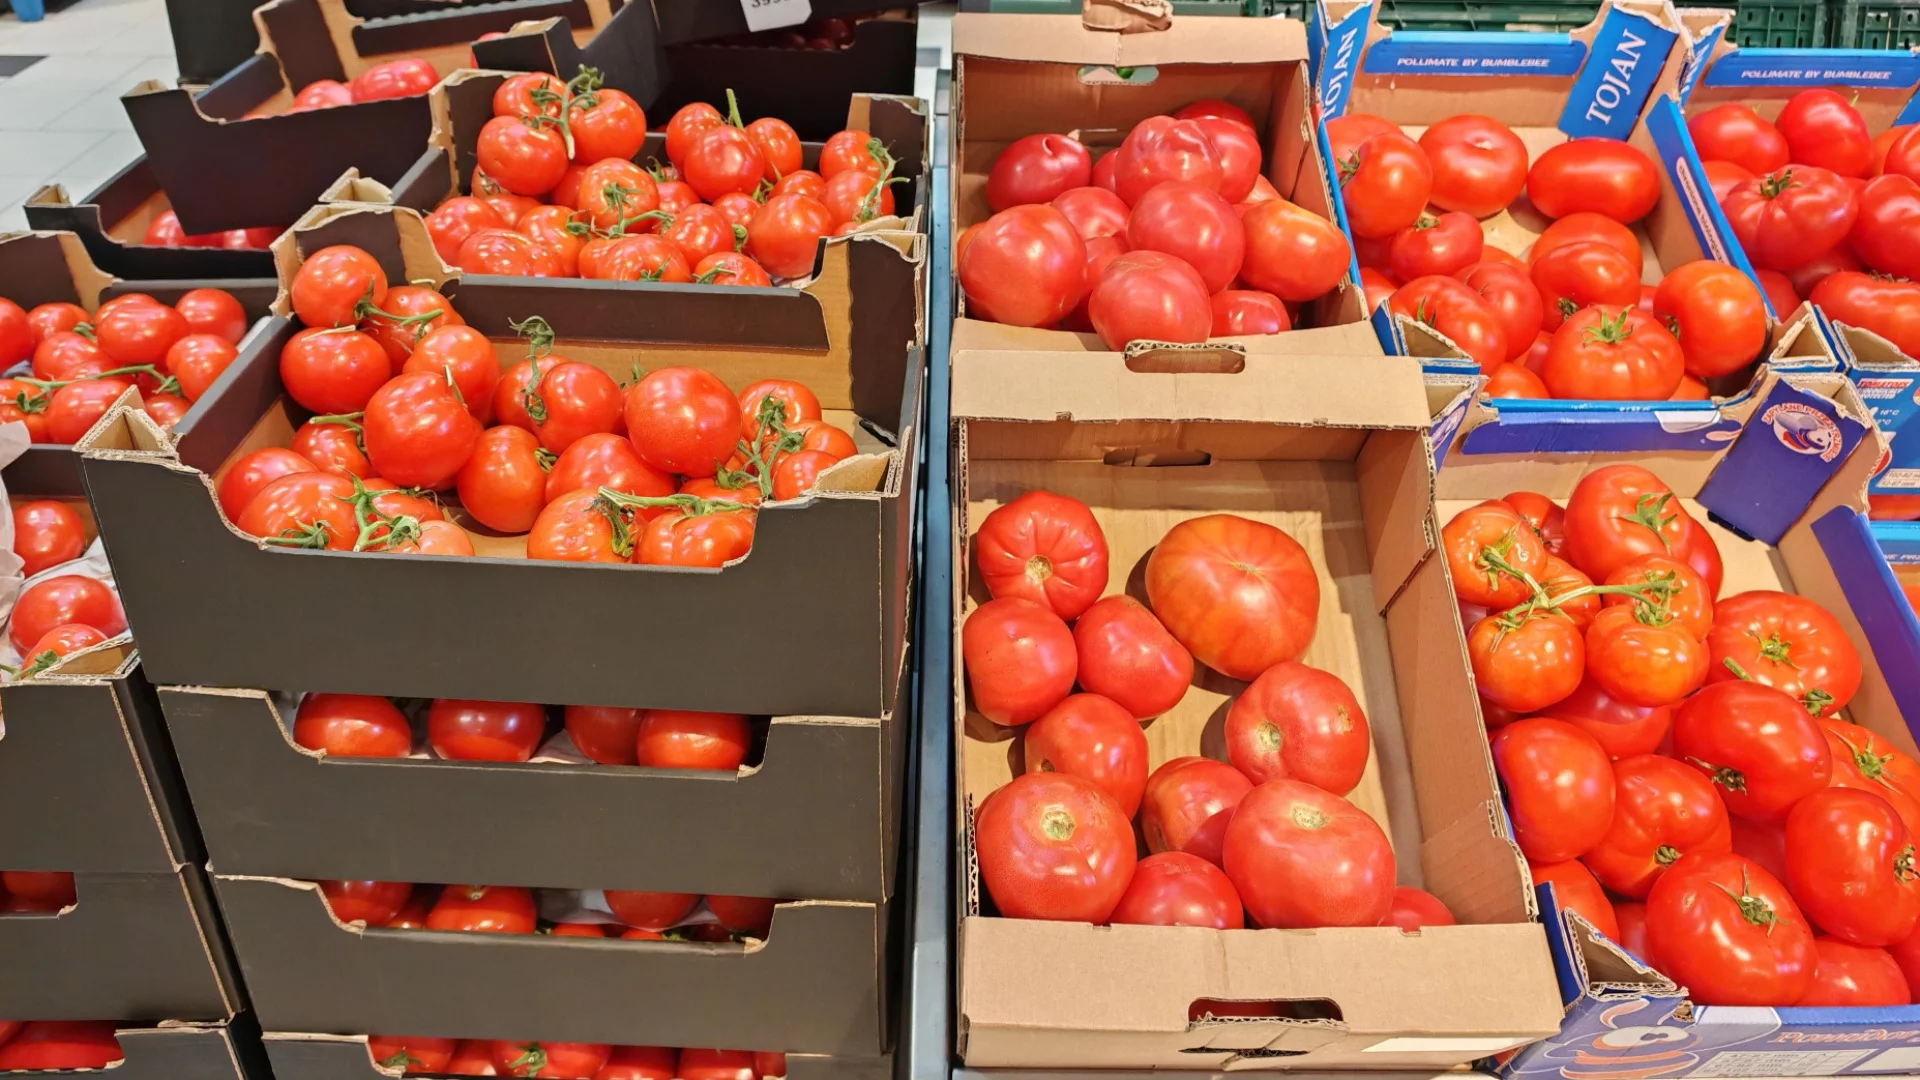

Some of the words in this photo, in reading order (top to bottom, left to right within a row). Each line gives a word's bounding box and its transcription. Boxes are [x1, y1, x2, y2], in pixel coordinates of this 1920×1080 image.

[1397, 57, 1459, 67] POLLIMATE
[1461, 58, 1479, 67] BY
[1481, 58, 1550, 68] BUMBLEBEE
[1585, 28, 1647, 125] TOJAN
[1741, 70, 1803, 79] POLLIMATE
[1804, 70, 1821, 79] BY
[1823, 71, 1892, 80] BUMBLEBEE
